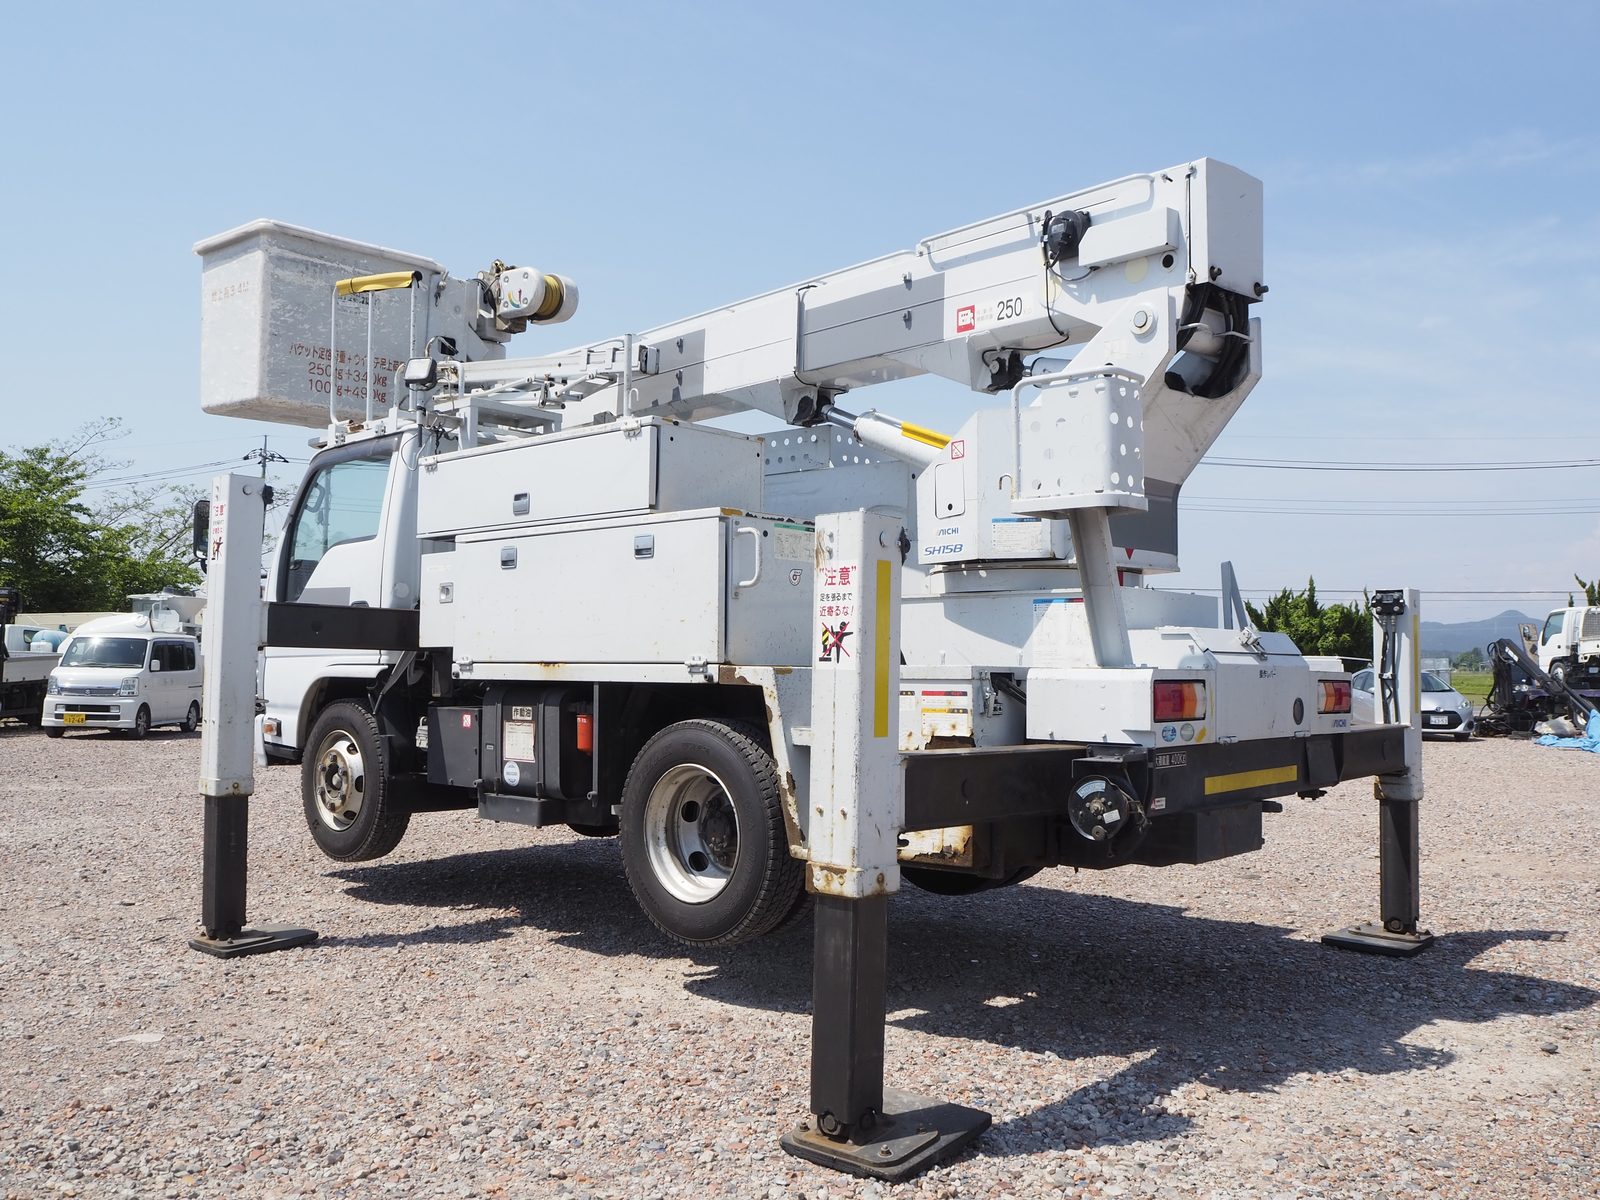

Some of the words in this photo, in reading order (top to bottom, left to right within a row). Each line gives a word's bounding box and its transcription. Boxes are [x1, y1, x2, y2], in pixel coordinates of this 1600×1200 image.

[997, 297, 1022, 321] 250
[937, 527, 959, 536] AICHI
[924, 543, 963, 556] SH15B
[819, 592, 853, 602] 足を張るまで
[513, 707, 532, 718] 作動油
